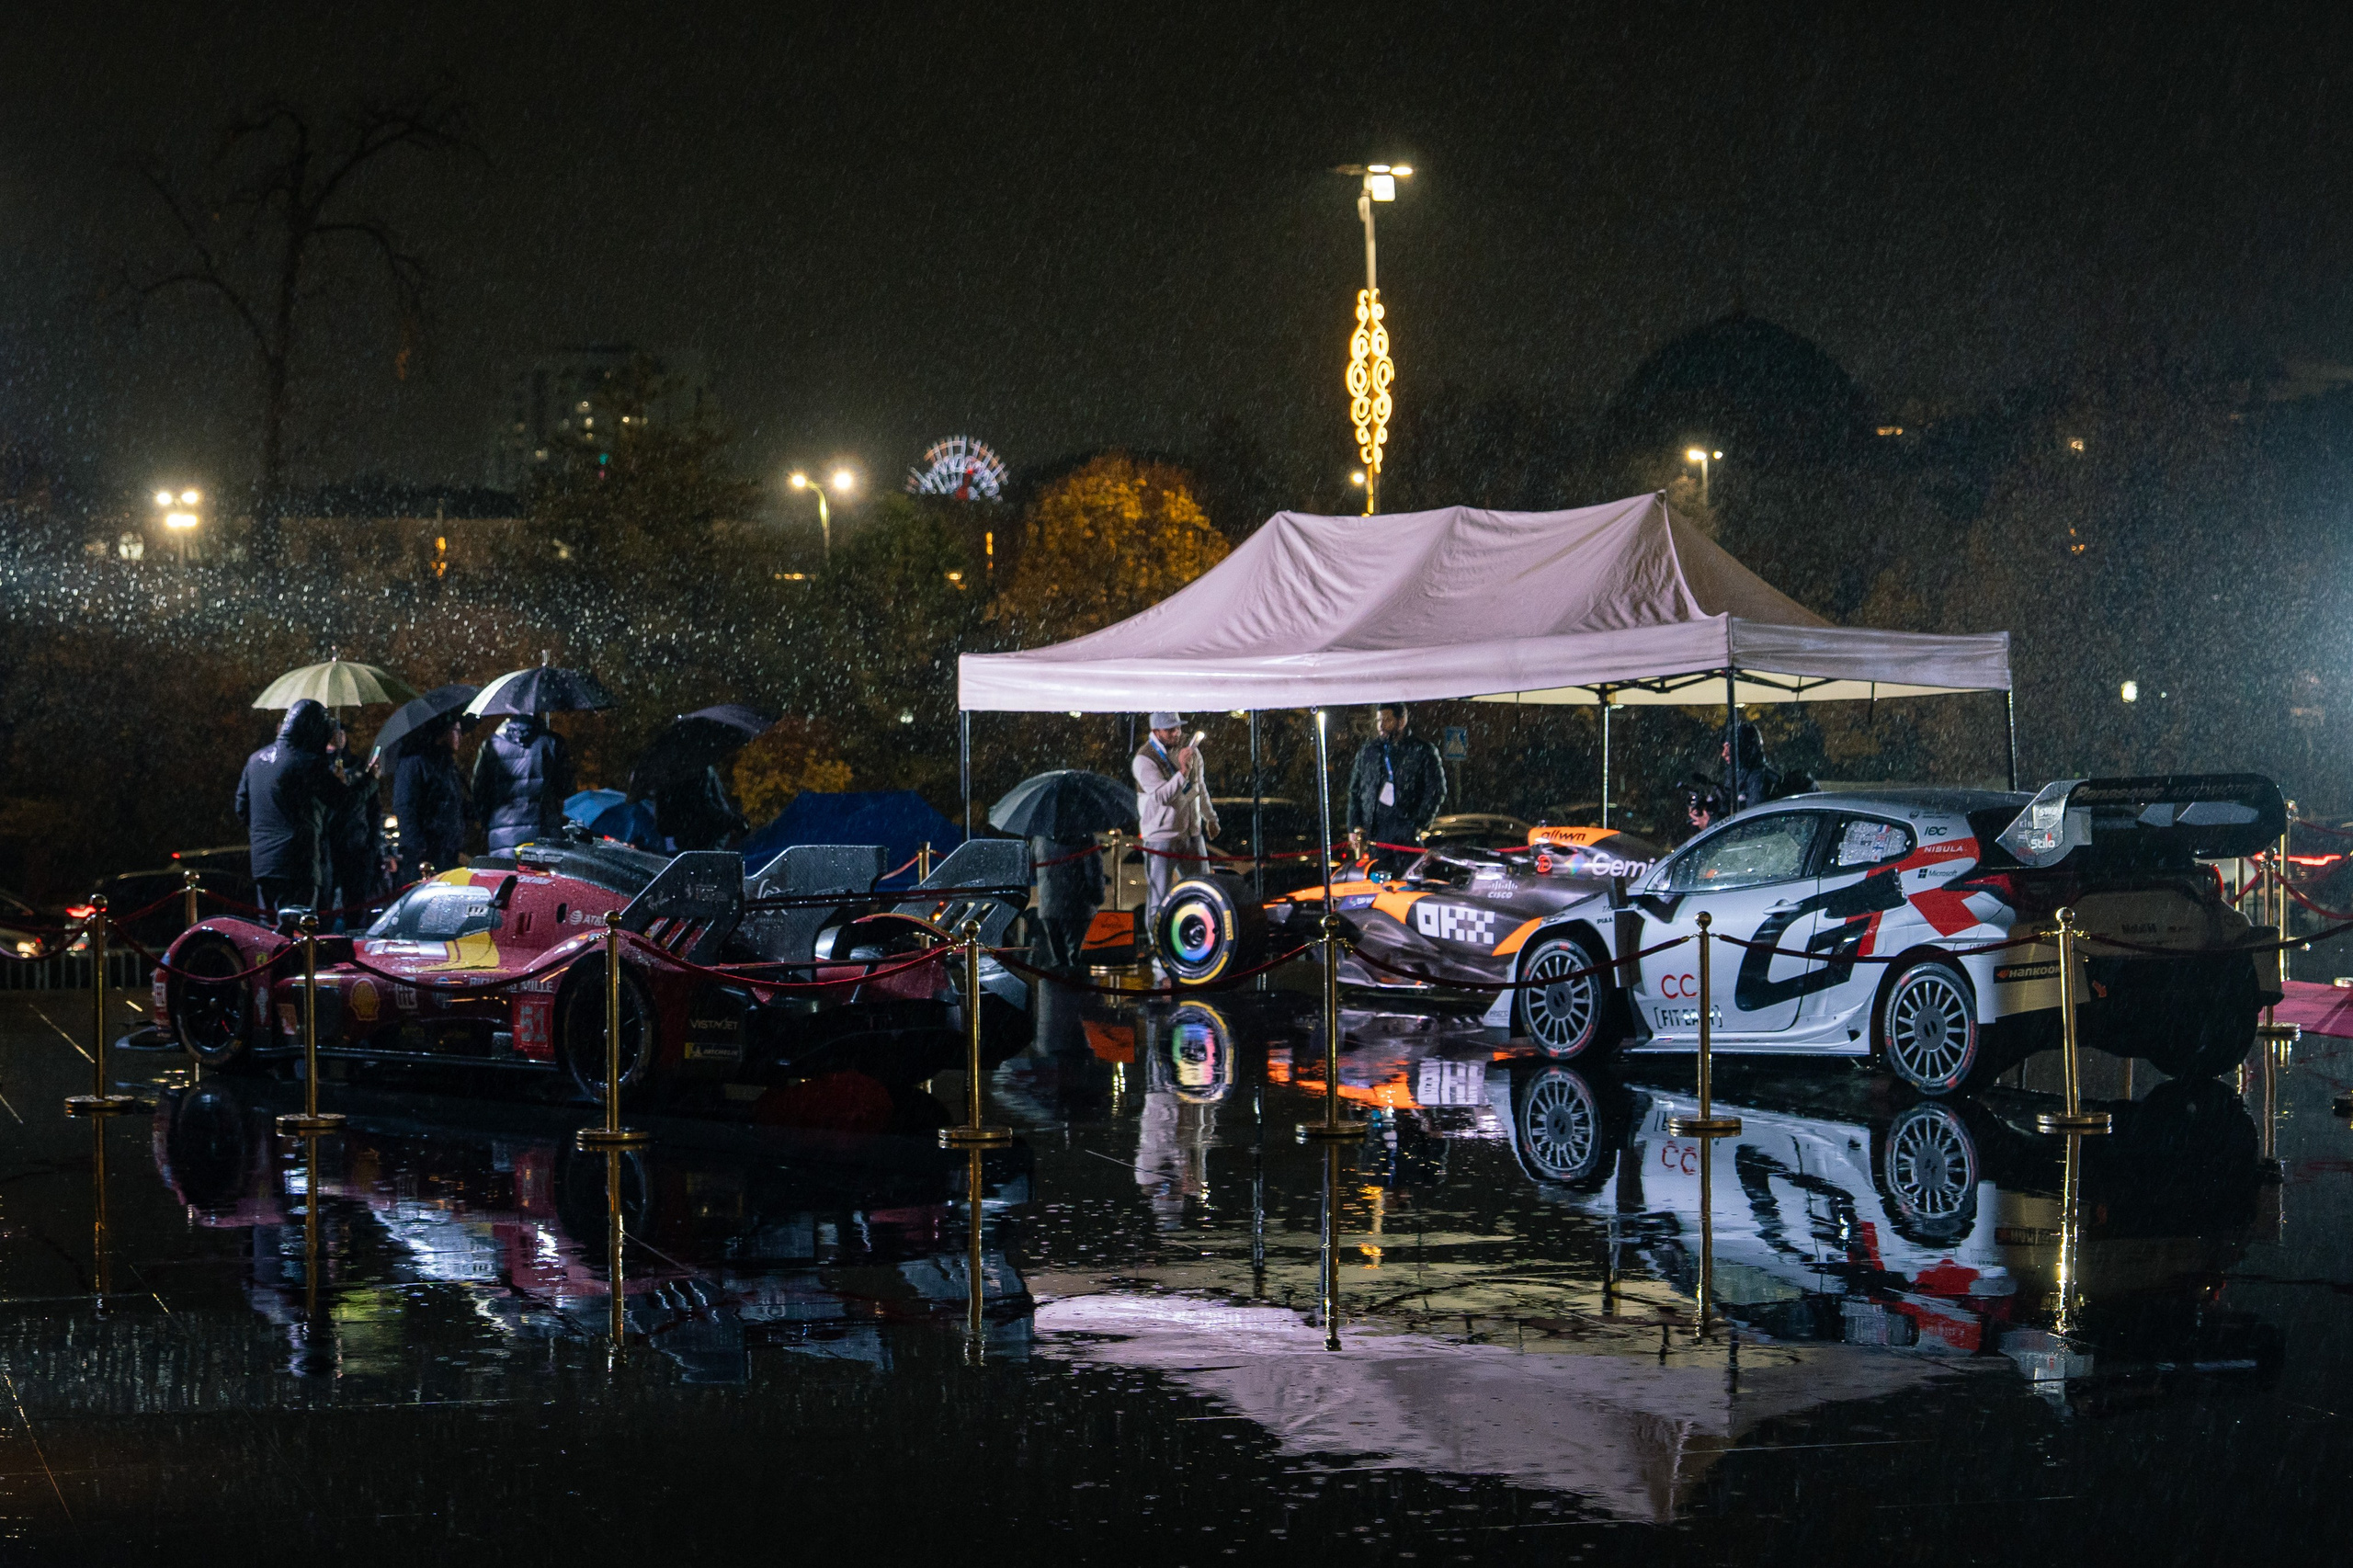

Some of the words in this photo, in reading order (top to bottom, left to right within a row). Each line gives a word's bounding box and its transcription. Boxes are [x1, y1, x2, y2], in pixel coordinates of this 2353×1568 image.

[1540, 829, 1586, 841] allwyn
[2030, 833, 2056, 849] Stilo
[1416, 902, 1495, 945] OKX
[519, 1006, 548, 1042] 51
